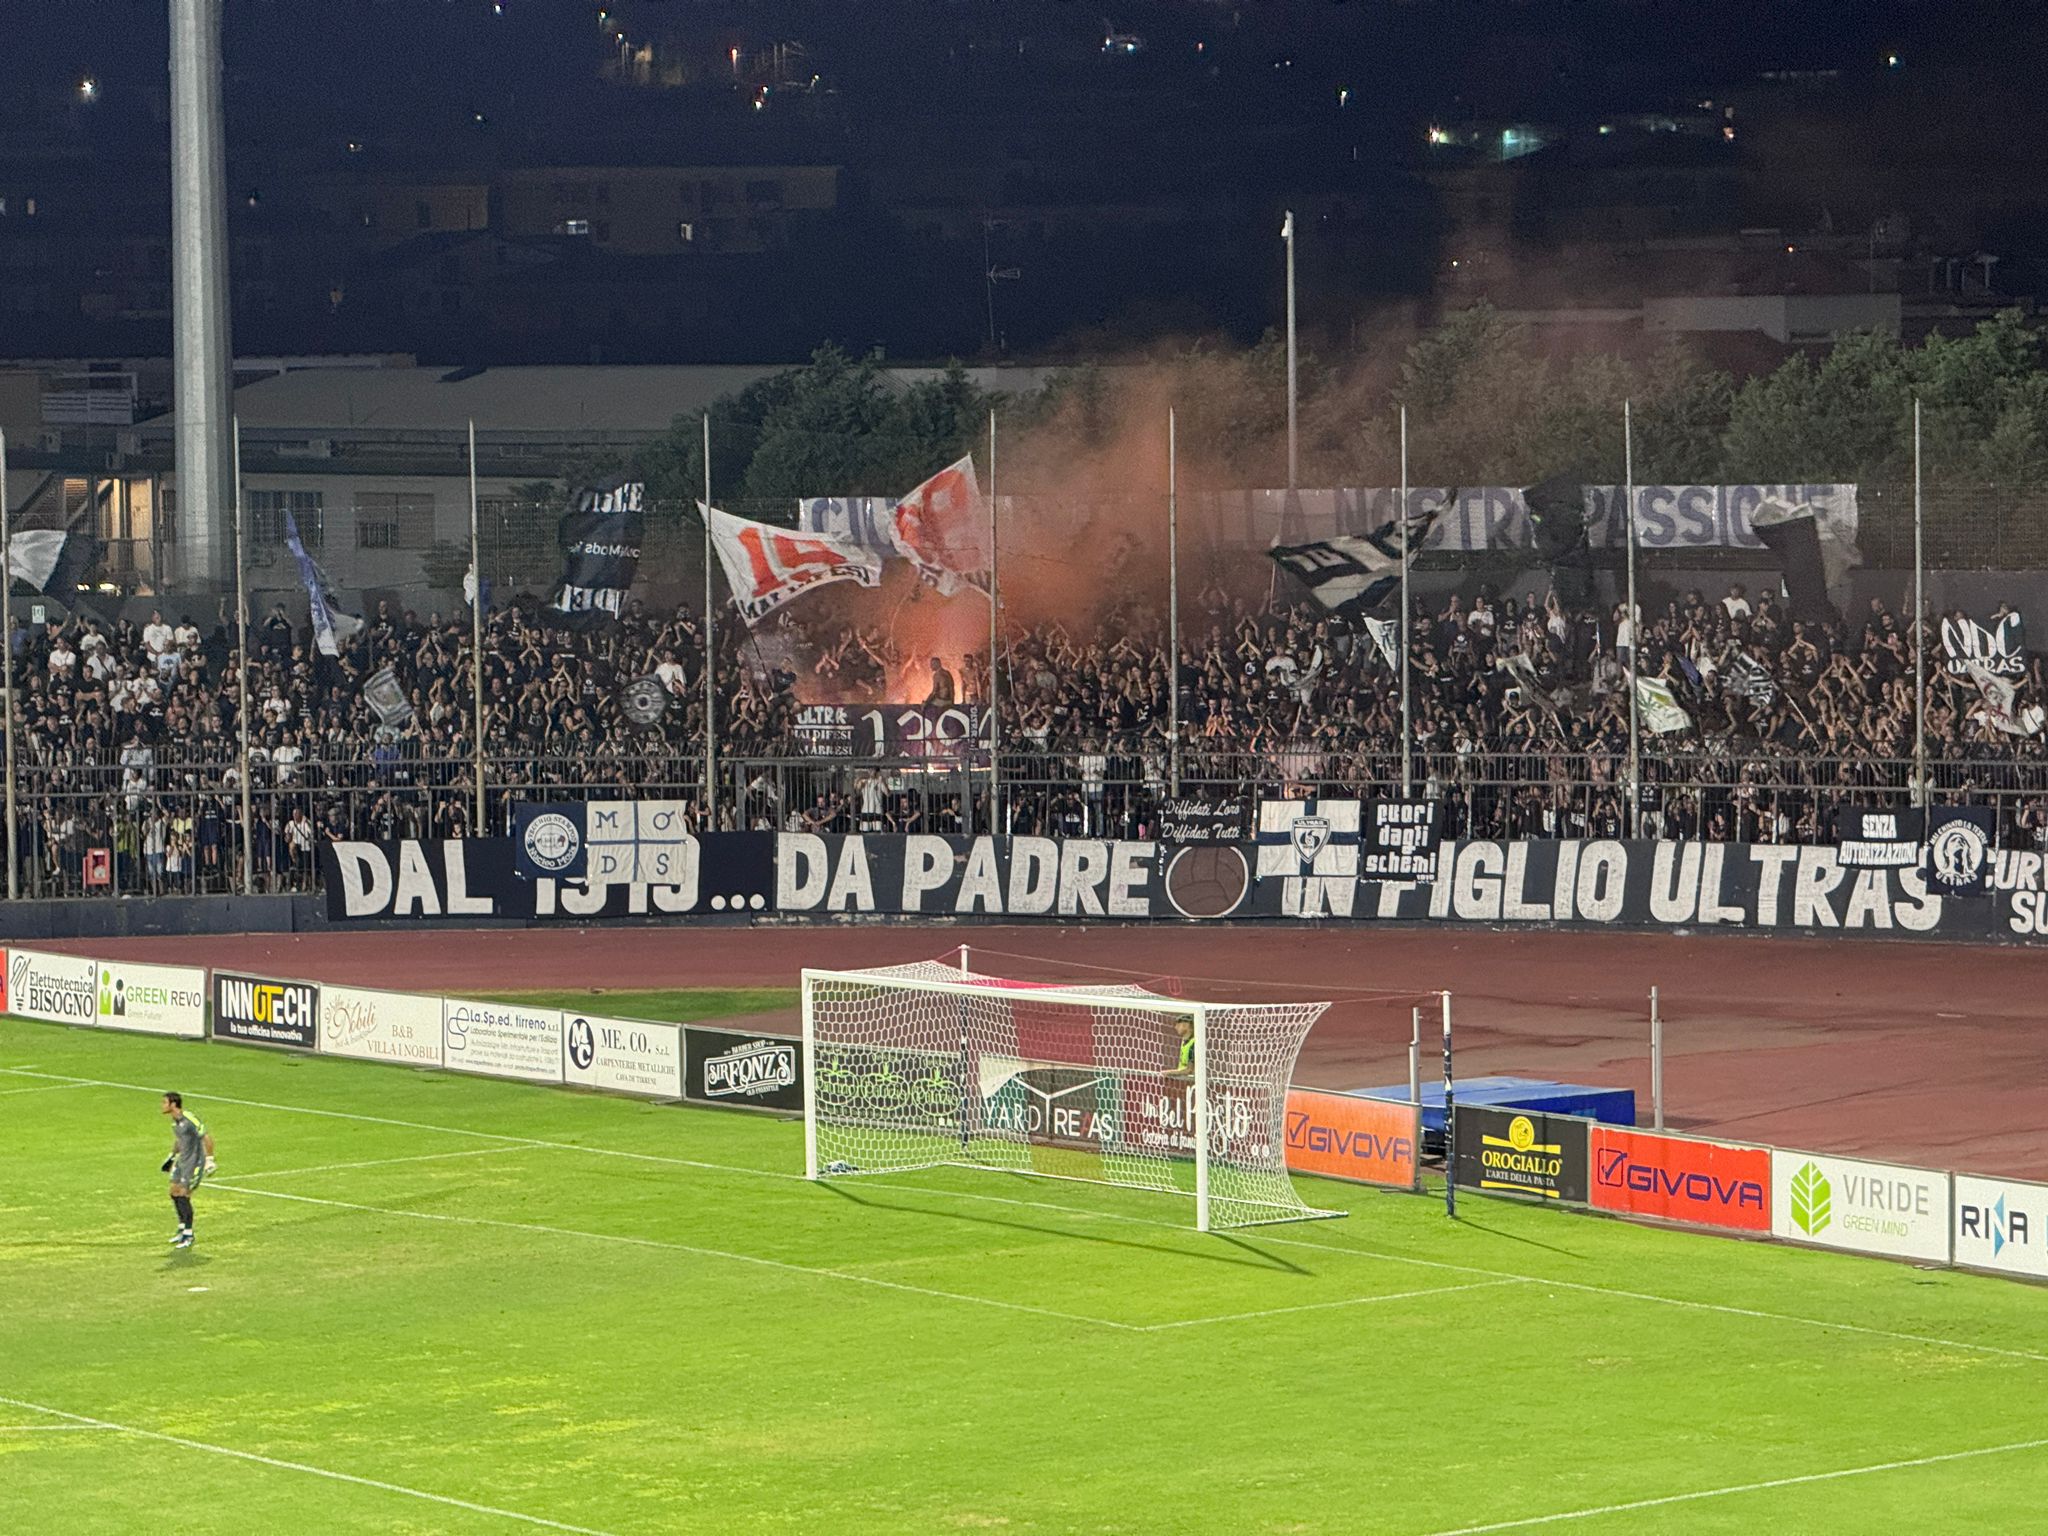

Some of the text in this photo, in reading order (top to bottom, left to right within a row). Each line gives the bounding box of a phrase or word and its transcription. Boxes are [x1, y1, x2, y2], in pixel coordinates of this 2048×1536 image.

[1941, 612, 2022, 659] NDC
[1947, 656, 2026, 675] URAS
[1165, 799, 1211, 821] Diffidati
[1161, 822, 1241, 843] Diffidati Tutti
[1378, 819, 1430, 855] dagli
[1862, 814, 1897, 839] SENZA
[1365, 852, 1437, 874] schemi
[331, 839, 494, 917] DAL
[776, 833, 875, 910] DA
[901, 834, 1156, 915] PADRE
[1649, 840, 1943, 932] ULTRAS
[29, 970, 94, 995] Elettrotecnica
[29, 988, 94, 1018] BISOGNO
[126, 985, 202, 1008] GREEN REVO
[221, 979, 312, 1028] INNOTECH
[391, 1024, 414, 1039] B&B
[601, 1027, 626, 1051] ME.
[629, 1031, 652, 1055] CO.
[367, 1039, 397, 1056] VILLA
[404, 1044, 440, 1060] NOBILI
[1159, 1095, 1185, 1127] Bel
[1308, 1126, 1412, 1164] GIVOVA
[1481, 1150, 1561, 1176] OROGIALLO
[1510, 1172, 1533, 1185] DELLA
[1627, 1164, 1763, 1210] GIVOVA
[1843, 1174, 1929, 1216] VIRIDE
[1843, 1214, 1908, 1237] GREEN MIND
